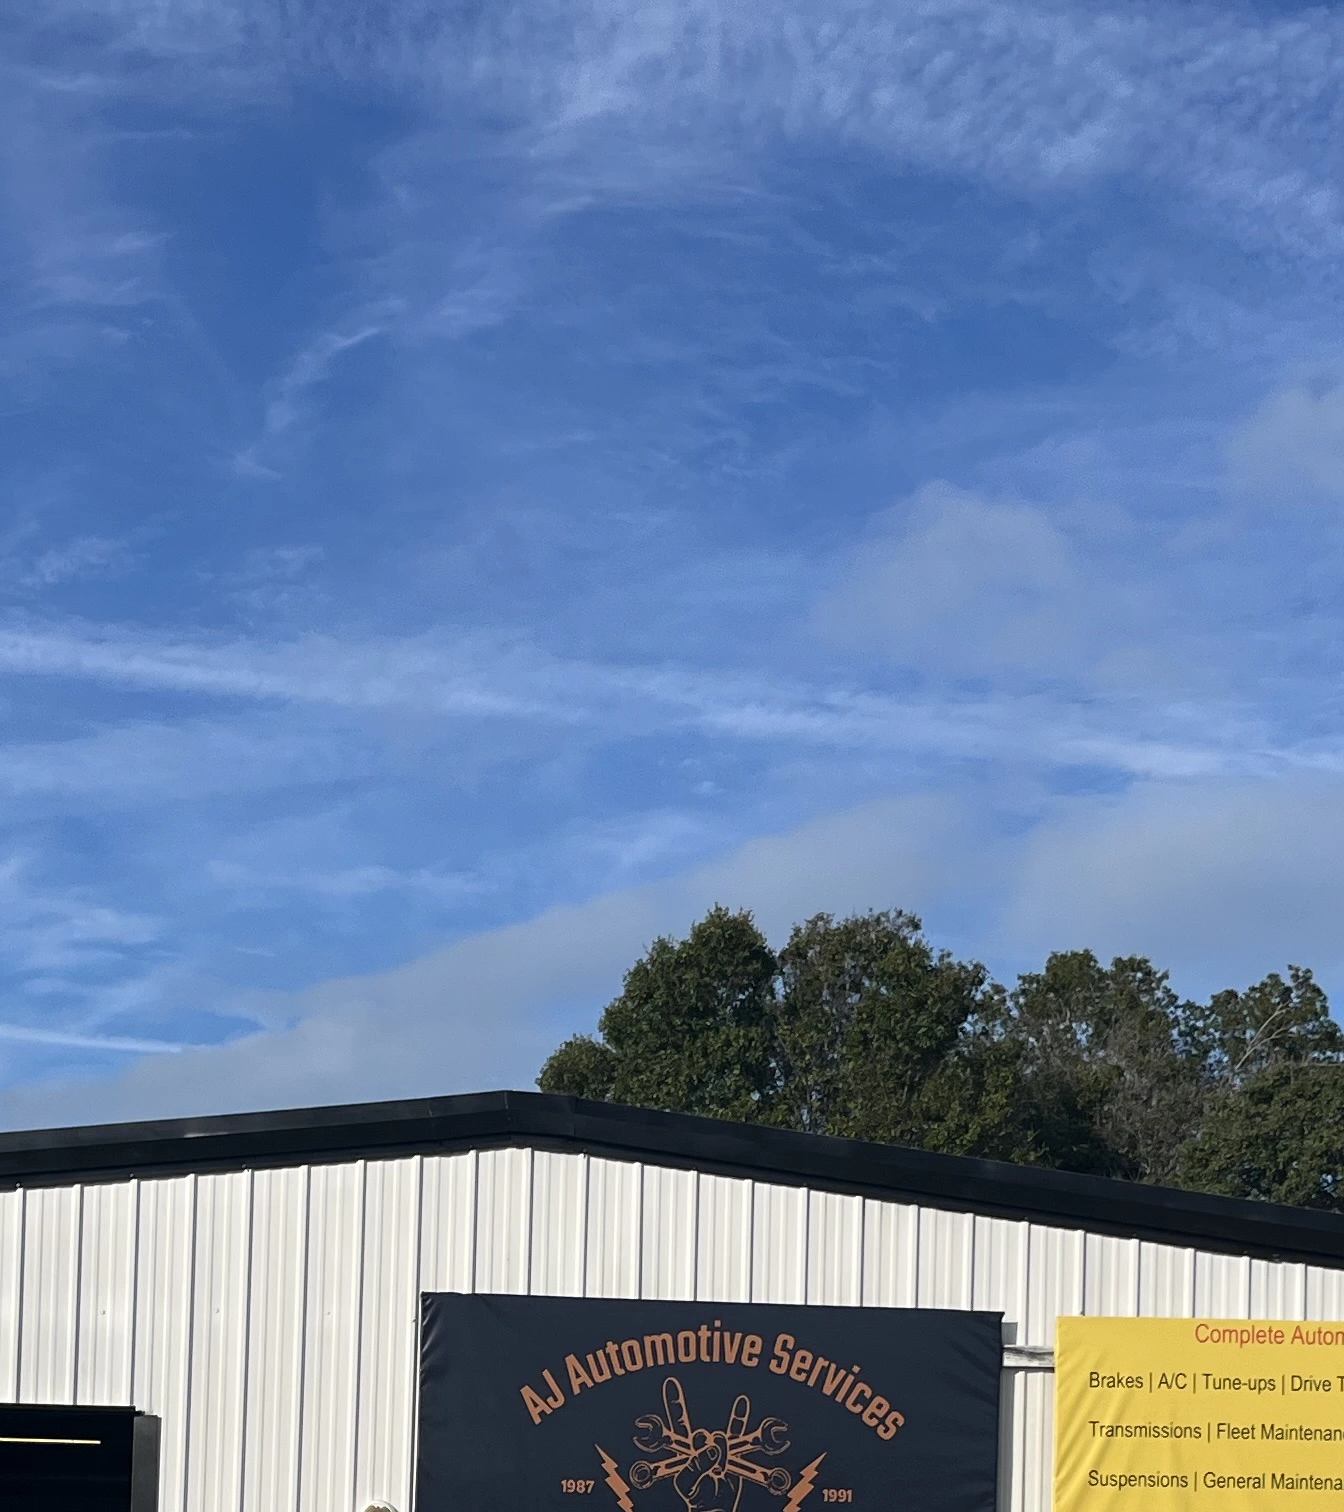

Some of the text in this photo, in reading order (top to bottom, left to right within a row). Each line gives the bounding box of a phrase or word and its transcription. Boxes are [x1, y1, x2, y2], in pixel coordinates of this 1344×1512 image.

[1196, 1324, 1285, 1348] Complete
[520, 1320, 904, 1444] AJ Automotive Services
[1090, 1372, 1143, 1388] Brakes
[1158, 1373, 1187, 1389] A/C
[1202, 1374, 1275, 1393] Tune-ups
[1292, 1375, 1331, 1392] Drive
[1089, 1421, 1201, 1438] Transmissions
[1217, 1423, 1255, 1439] Fleet
[561, 1480, 594, 1493] 1987
[1088, 1470, 1188, 1490] Suspensions
[1204, 1472, 1265, 1489] General
[823, 1489, 852, 1502] 1991
